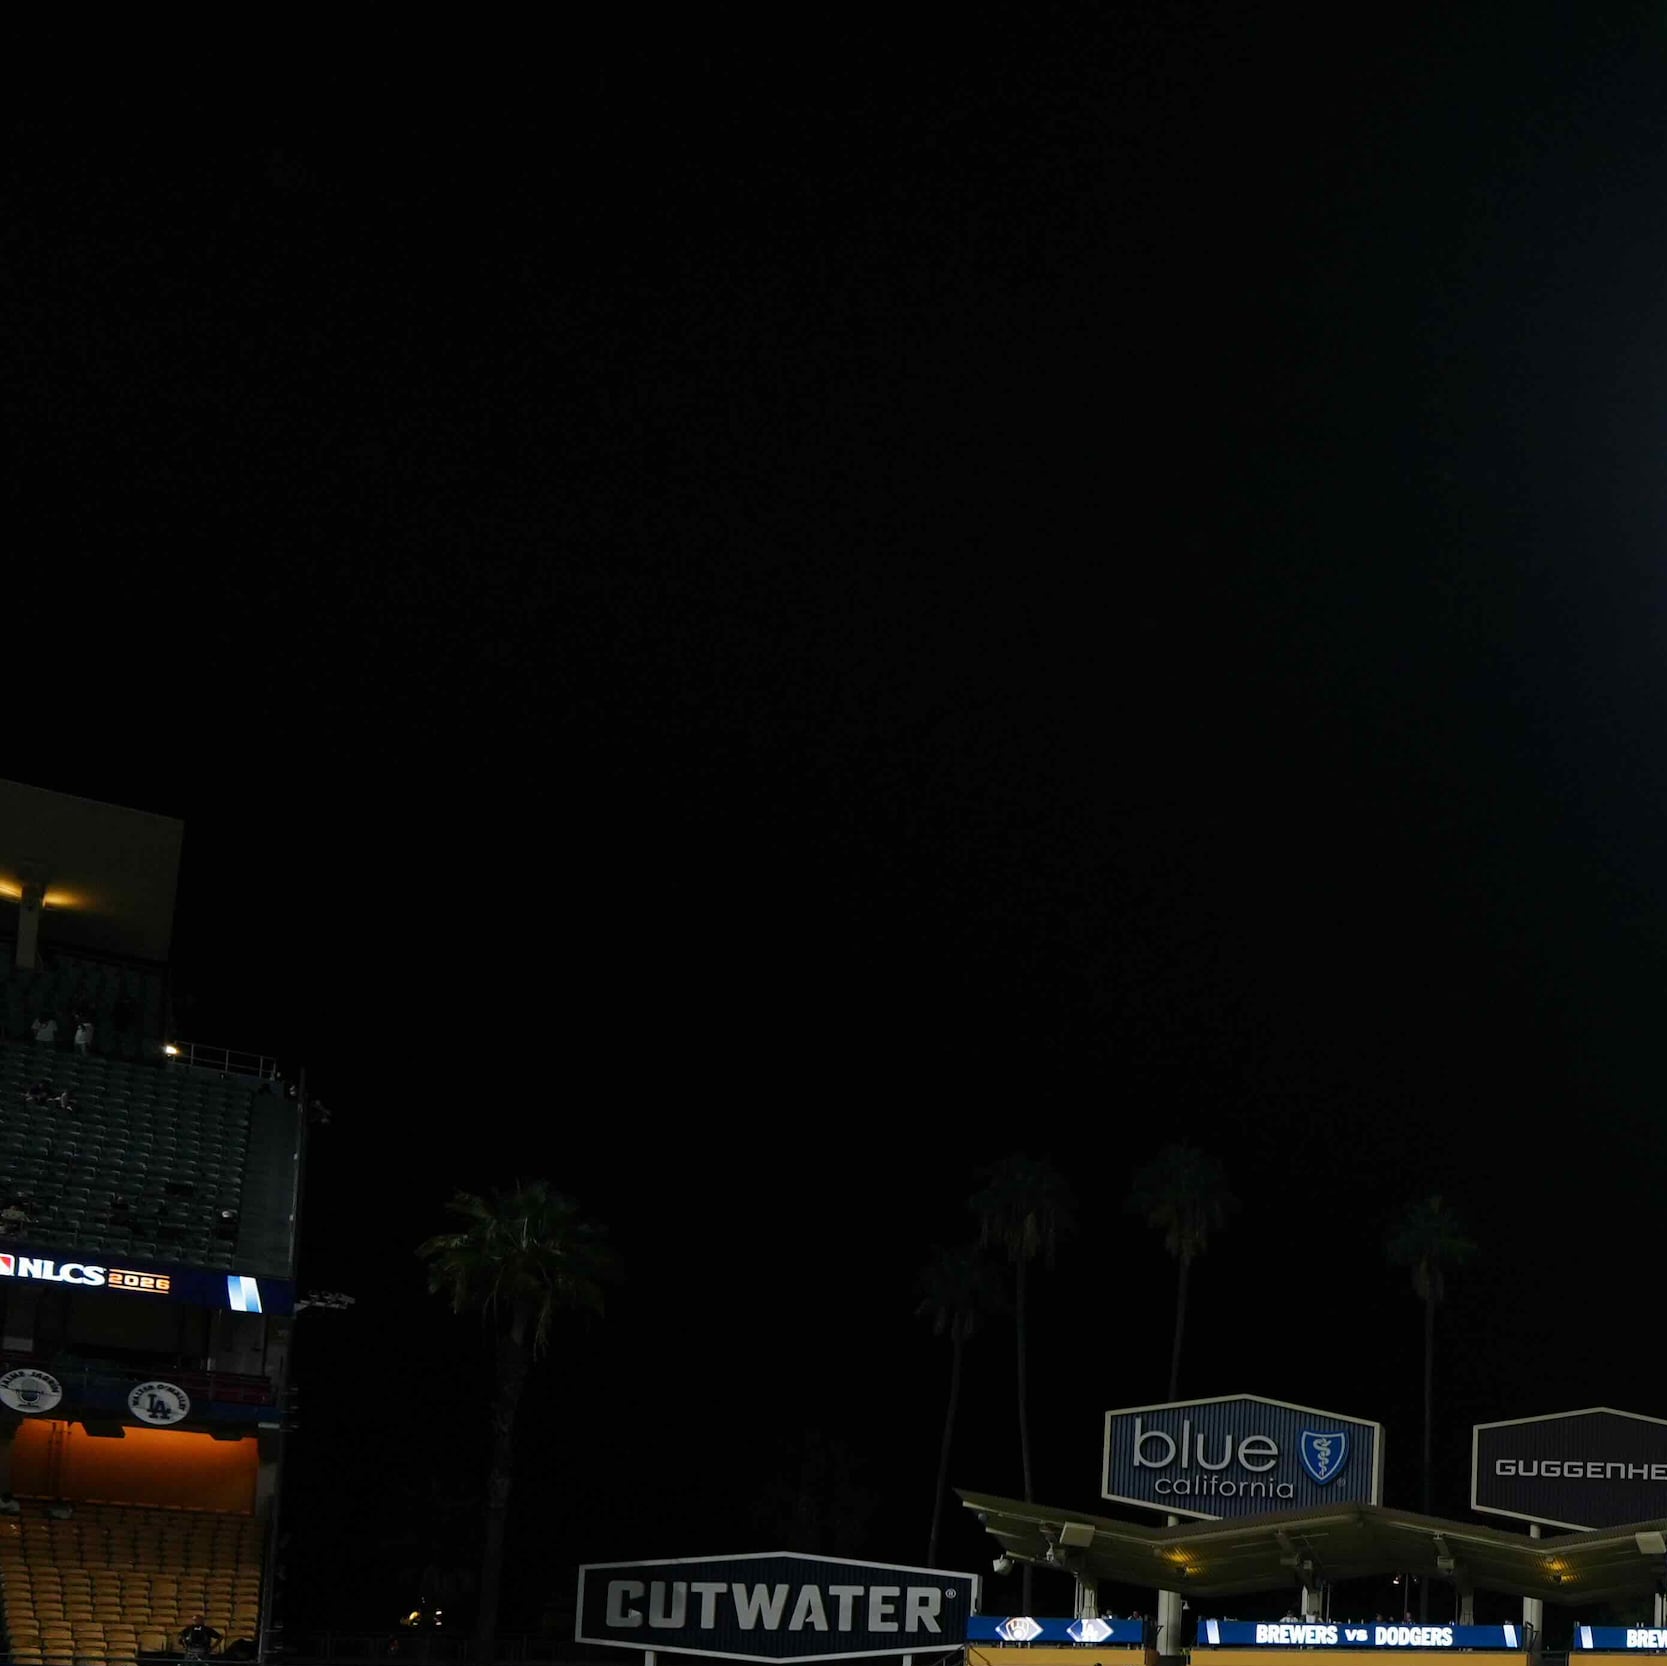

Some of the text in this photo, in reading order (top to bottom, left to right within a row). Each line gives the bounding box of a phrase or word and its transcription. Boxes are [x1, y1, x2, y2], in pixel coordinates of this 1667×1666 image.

[17, 1256, 170, 1290] NLCS 2026
[1133, 1417, 1279, 1472] blue
[1154, 1473, 1294, 1499] california
[604, 1579, 942, 1634] CUTWATER
[1256, 1624, 1338, 1646] BREWERS
[1375, 1626, 1453, 1648] DODGERS
